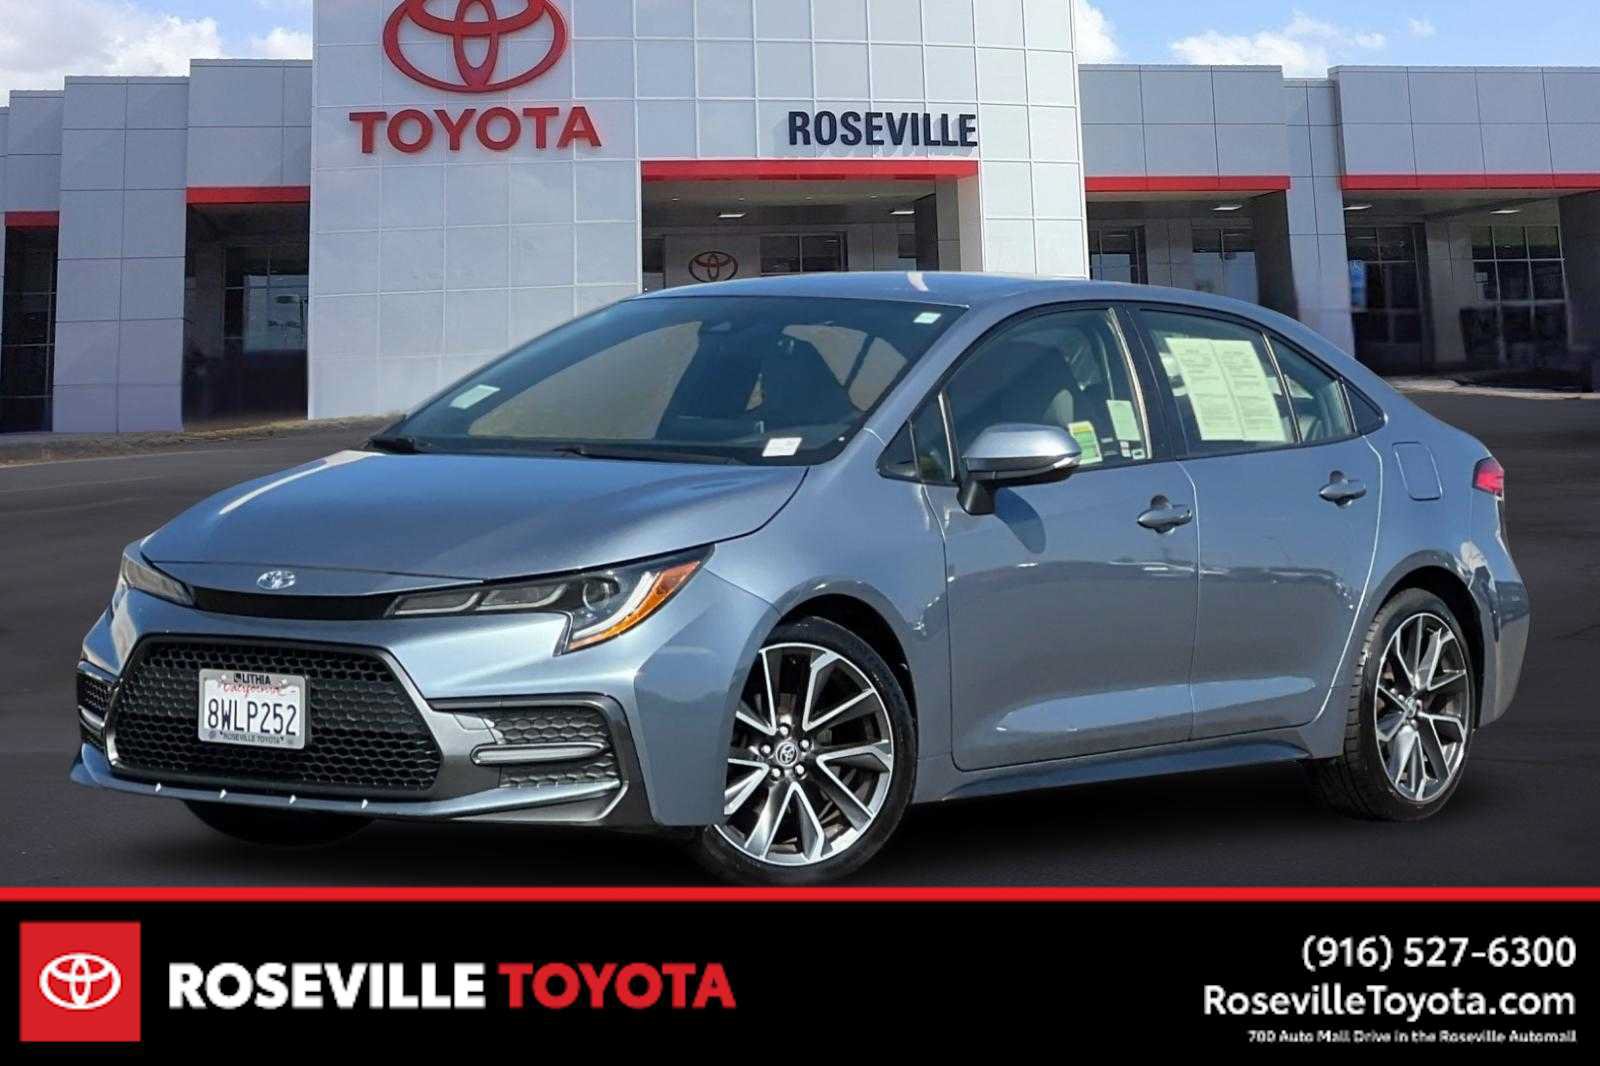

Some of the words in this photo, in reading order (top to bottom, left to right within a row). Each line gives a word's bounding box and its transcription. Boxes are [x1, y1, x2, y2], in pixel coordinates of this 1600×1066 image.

[349, 106, 602, 154] TOYOTA
[788, 111, 978, 147] ROSEVILLE
[242, 672, 271, 685] LITHIA
[207, 698, 297, 736] 8WLP252
